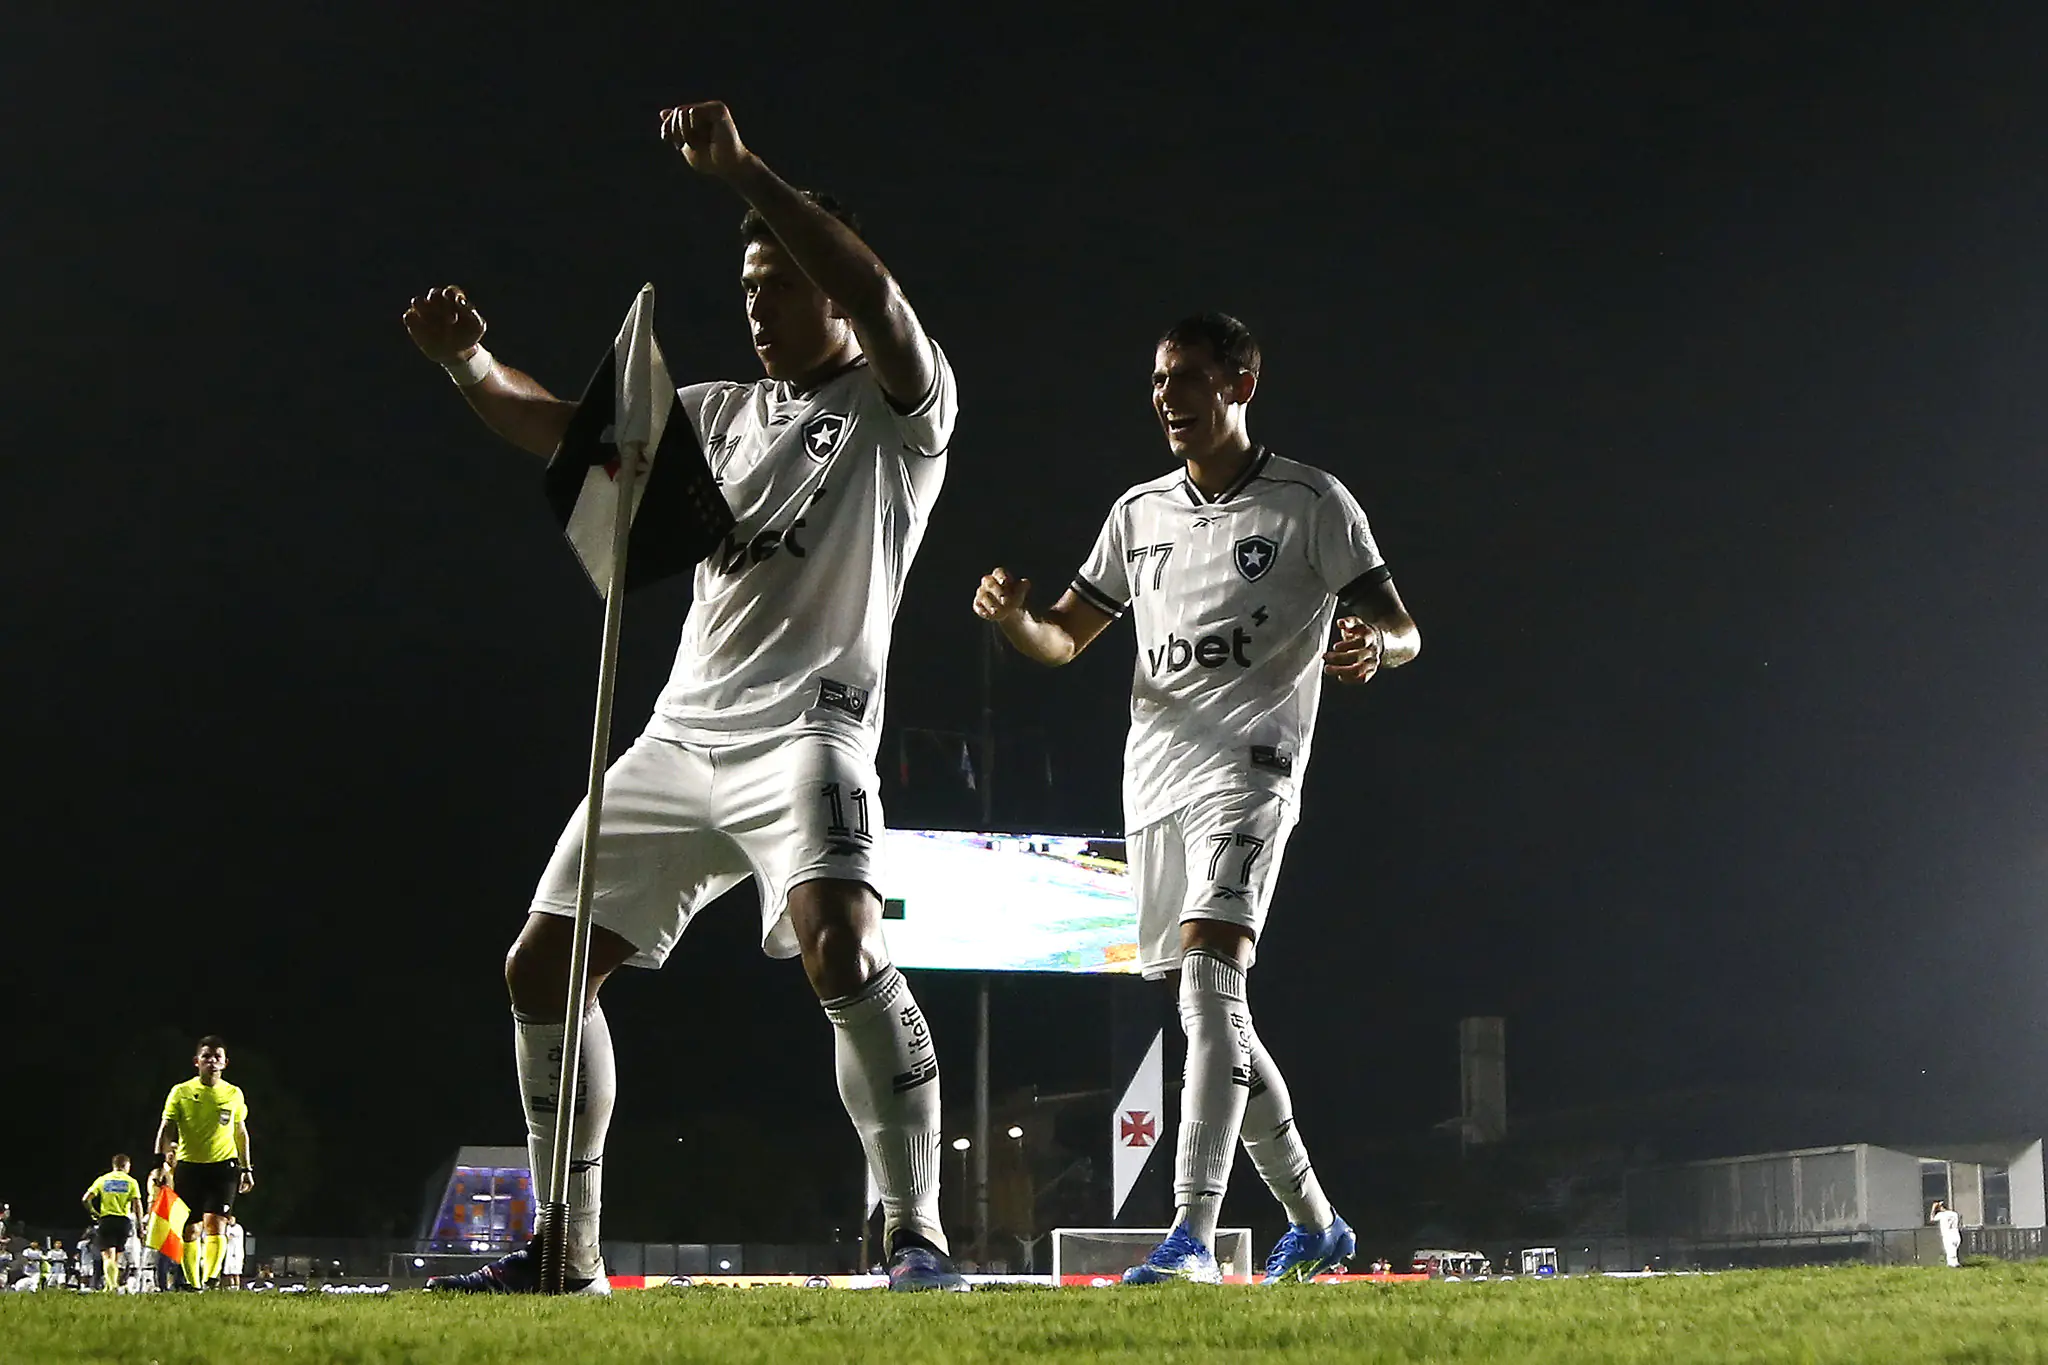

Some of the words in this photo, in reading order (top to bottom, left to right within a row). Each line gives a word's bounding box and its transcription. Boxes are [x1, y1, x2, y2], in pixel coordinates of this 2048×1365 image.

[719, 518, 806, 575] bet
[1127, 542, 1175, 597] 77
[1148, 627, 1252, 678] vbet
[821, 783, 873, 844] 11
[1206, 832, 1265, 886] 77
